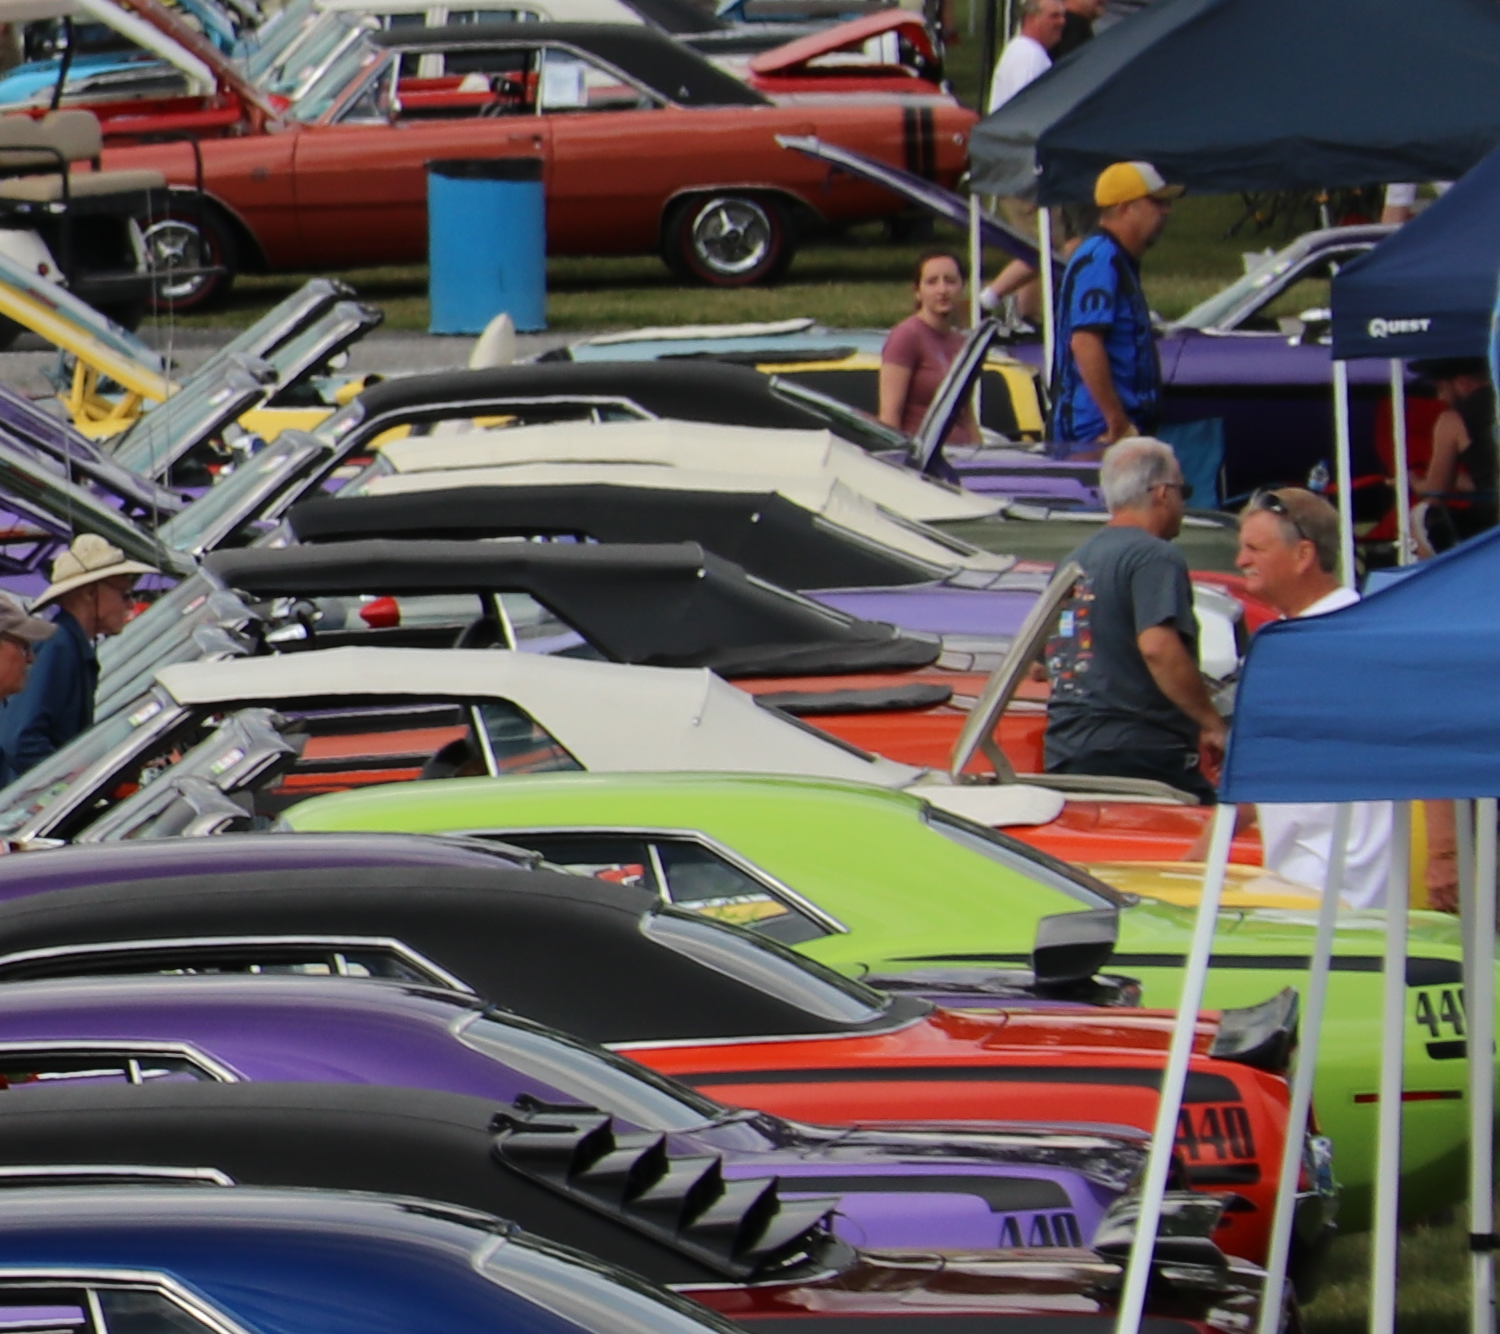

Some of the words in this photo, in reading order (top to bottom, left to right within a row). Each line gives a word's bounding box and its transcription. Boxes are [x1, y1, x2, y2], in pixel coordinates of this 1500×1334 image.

[1368, 318, 1432, 338] QUEST
[1415, 987, 1467, 1038] 44
[1177, 1106, 1256, 1160] 440
